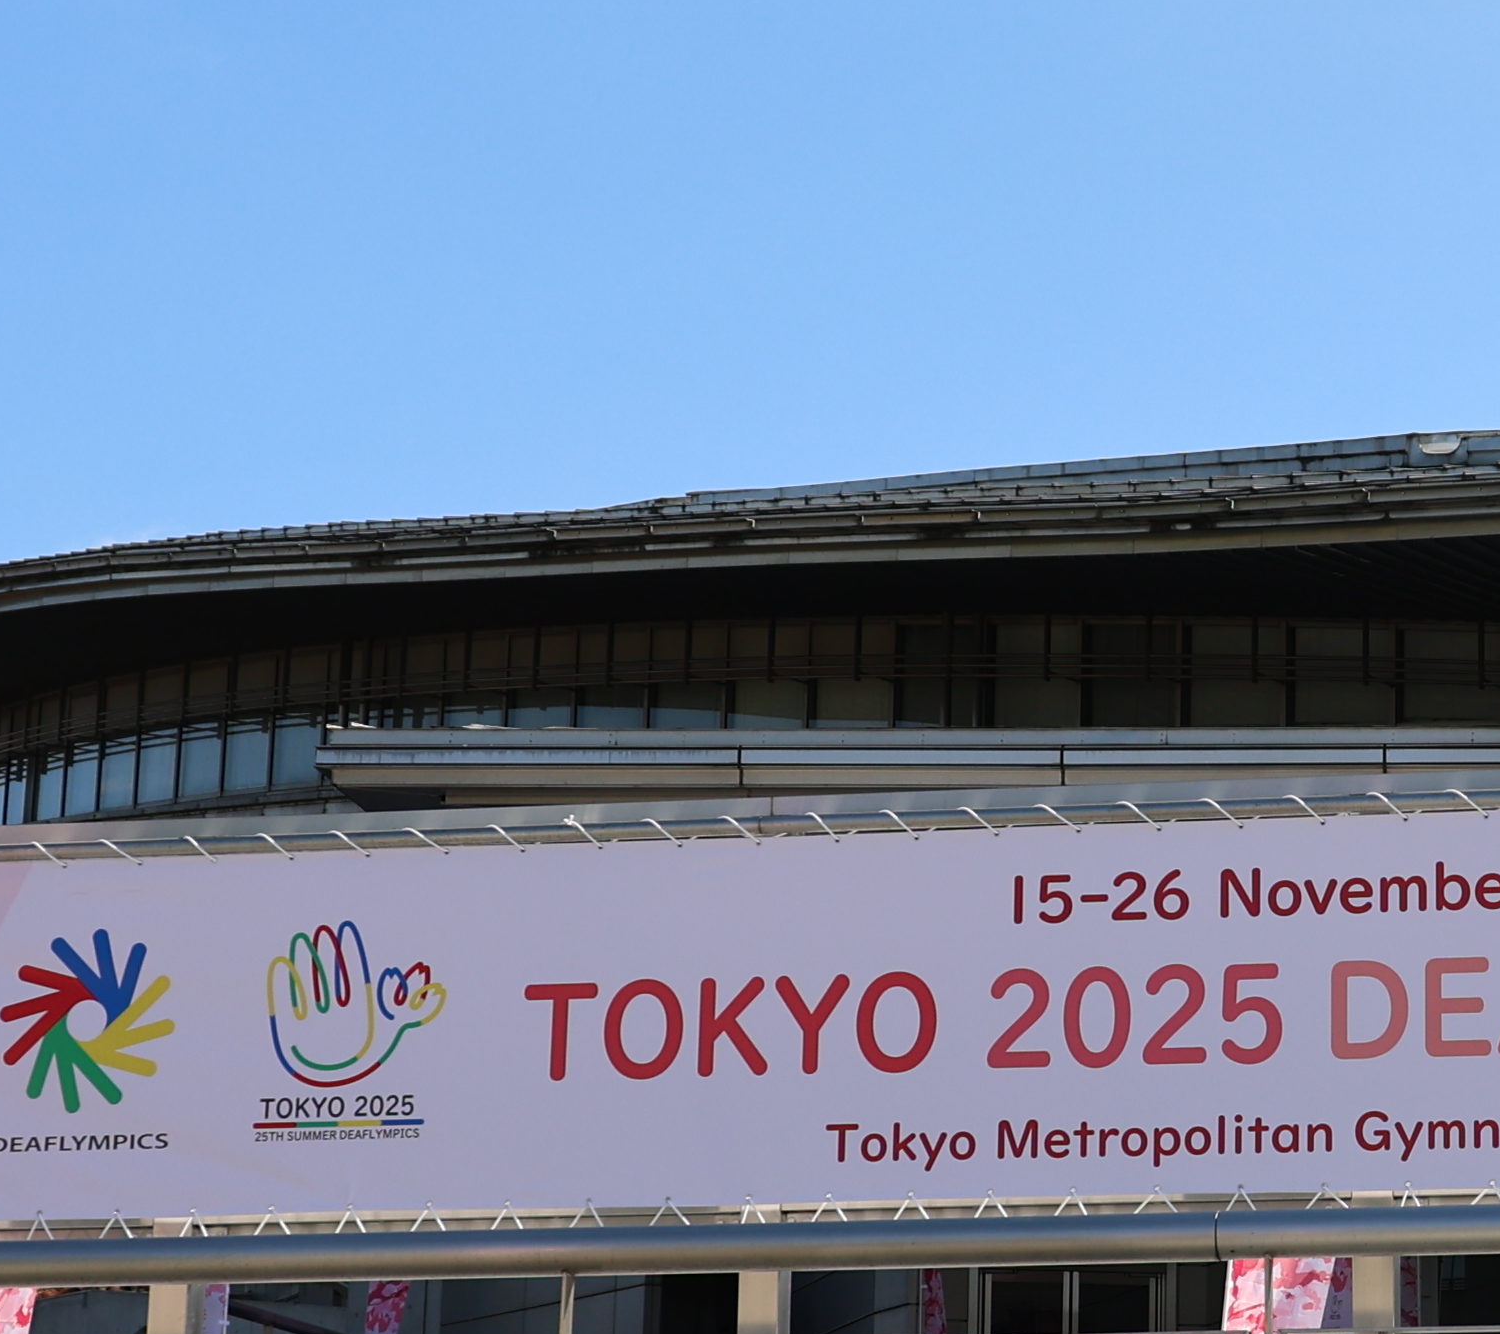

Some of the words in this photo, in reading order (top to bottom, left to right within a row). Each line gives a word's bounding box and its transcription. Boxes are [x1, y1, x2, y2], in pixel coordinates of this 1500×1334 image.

[1013, 868, 1190, 925] 15-26
[524, 971, 938, 1082] TOKYO
[986, 962, 1283, 1069] 2025
[254, 1130, 284, 1142] 25TH
[287, 1129, 337, 1142] SUMMER
[339, 1127, 420, 1140] DEAFLYMPICS
[259, 1096, 345, 1119] TOKYO
[354, 1095, 414, 1117] 2025
[825, 1121, 977, 1172] Tokyo
[997, 1114, 1333, 1168] Metropolitan
